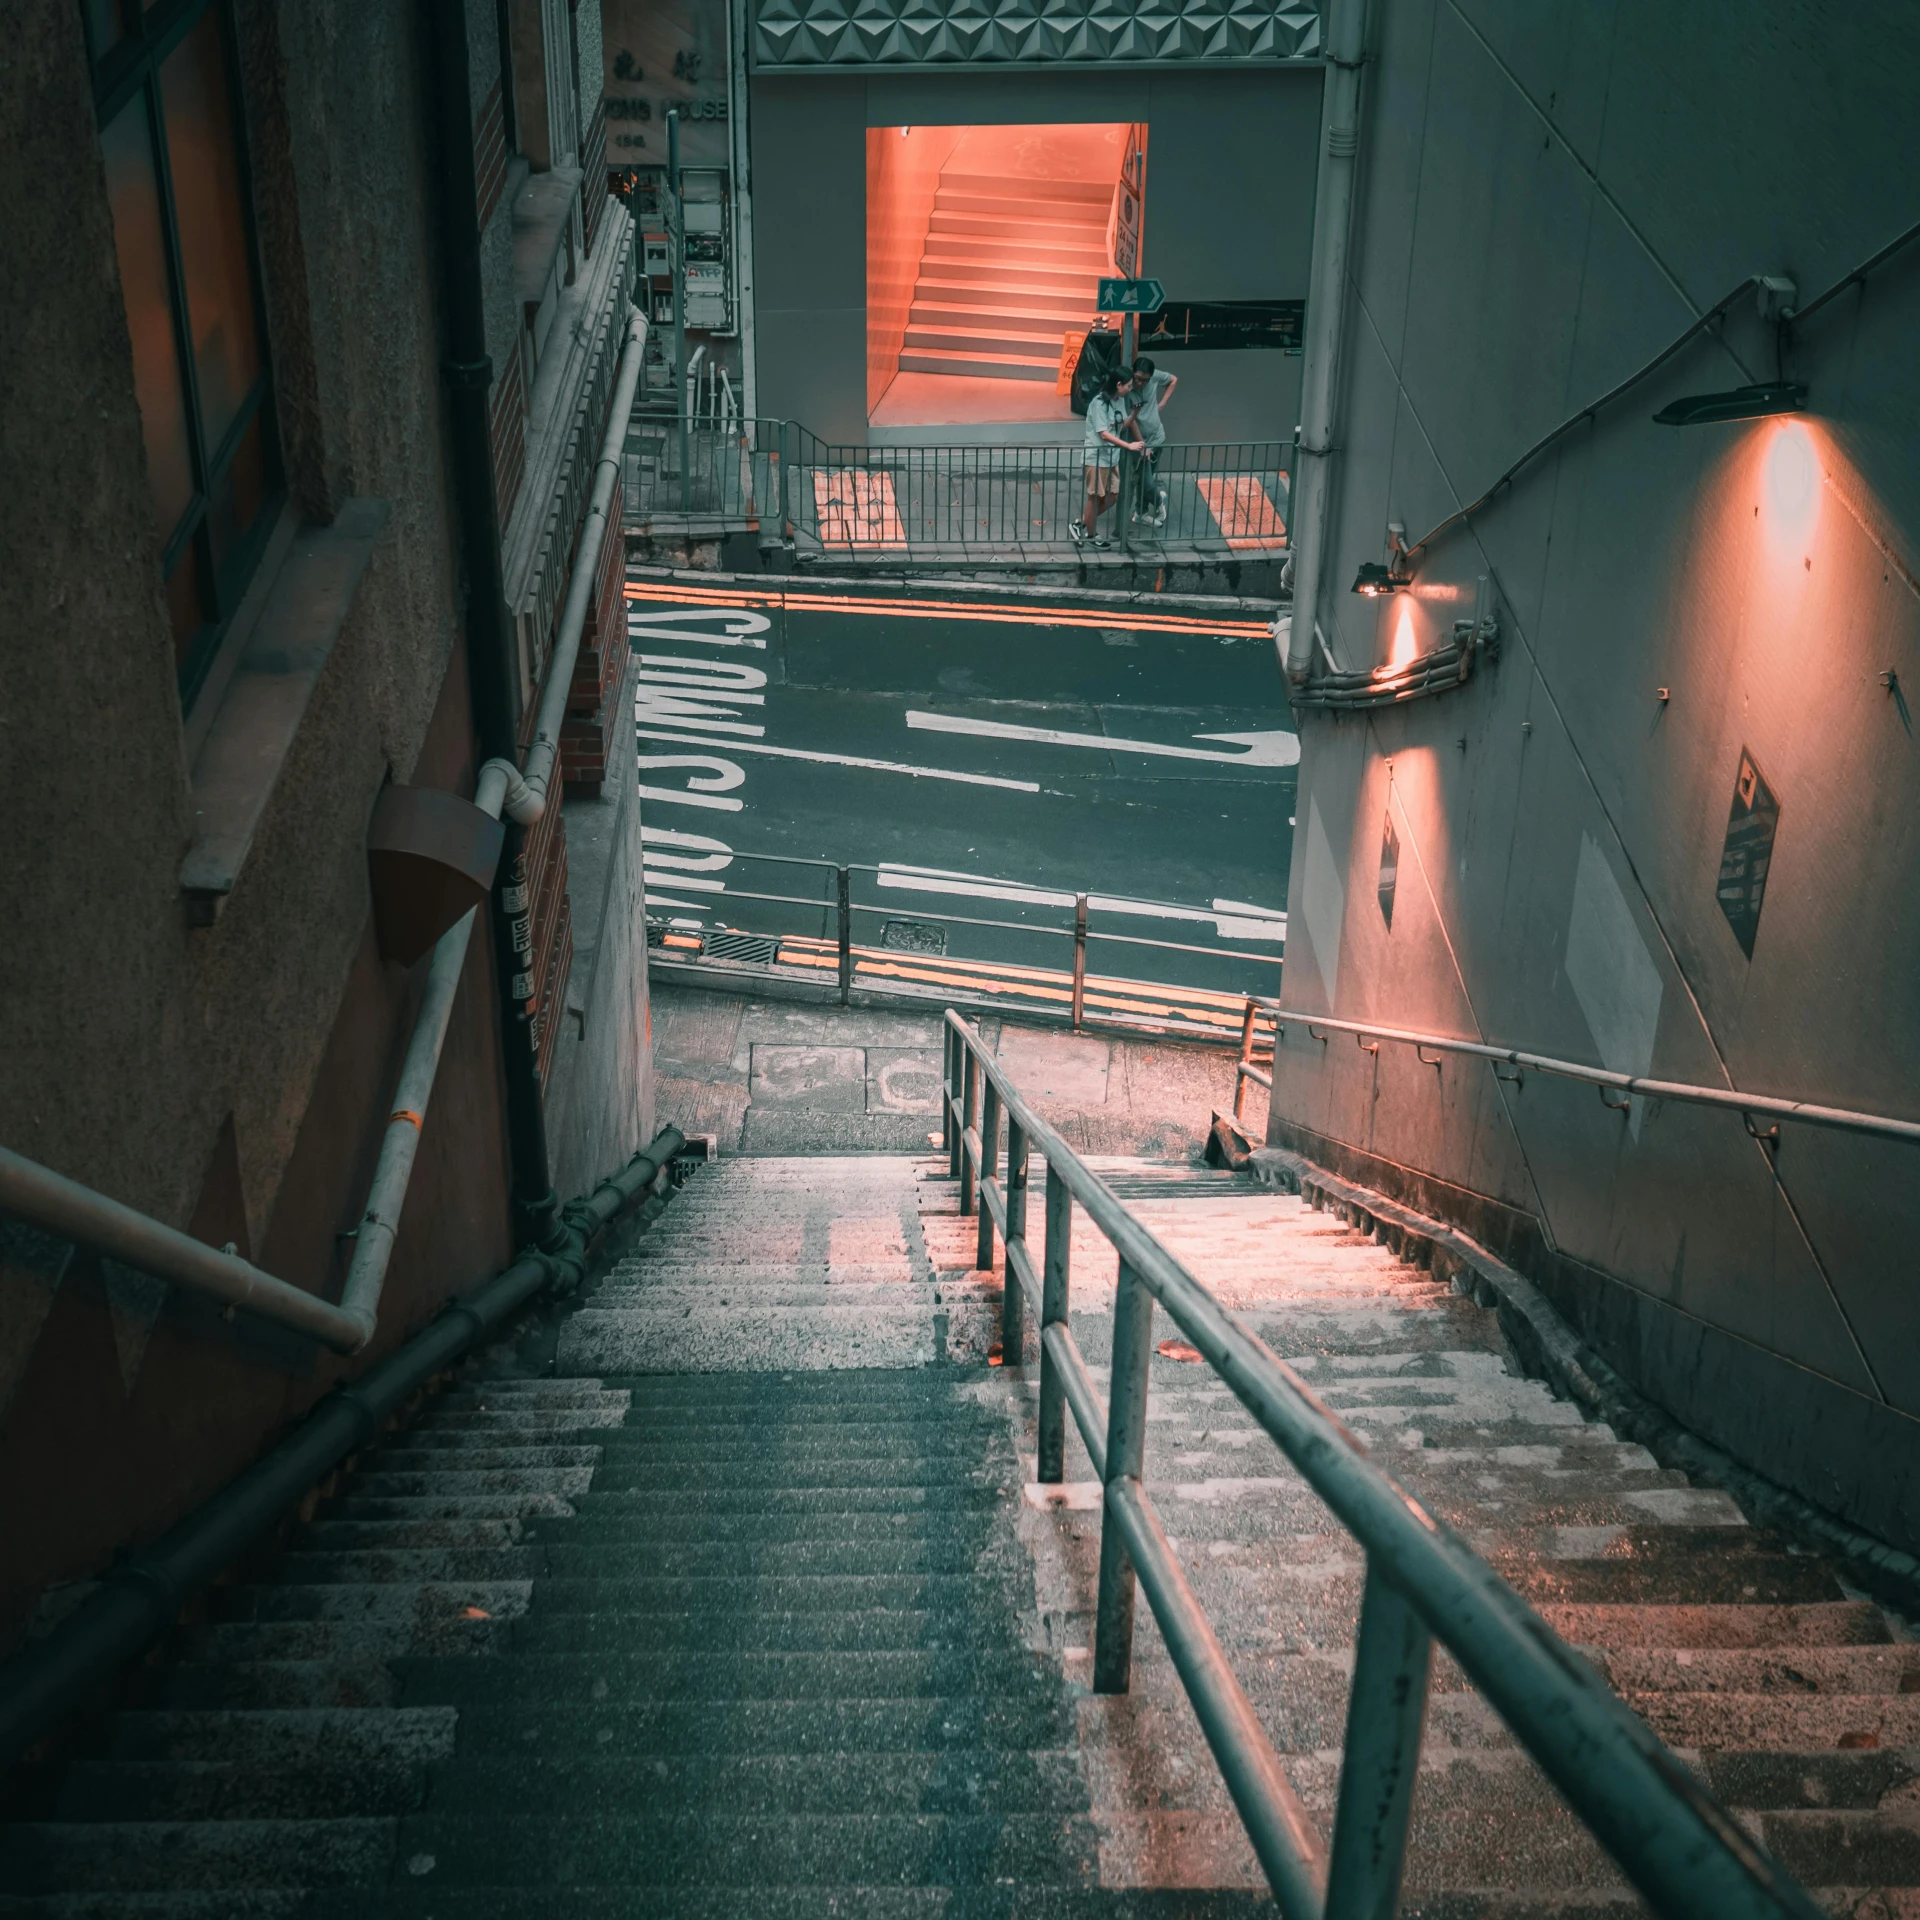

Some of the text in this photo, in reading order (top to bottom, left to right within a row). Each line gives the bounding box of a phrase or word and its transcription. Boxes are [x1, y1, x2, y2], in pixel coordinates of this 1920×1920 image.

[661, 98, 729, 120] HOUSE
[1119, 226, 1134, 254] 24 hrs
